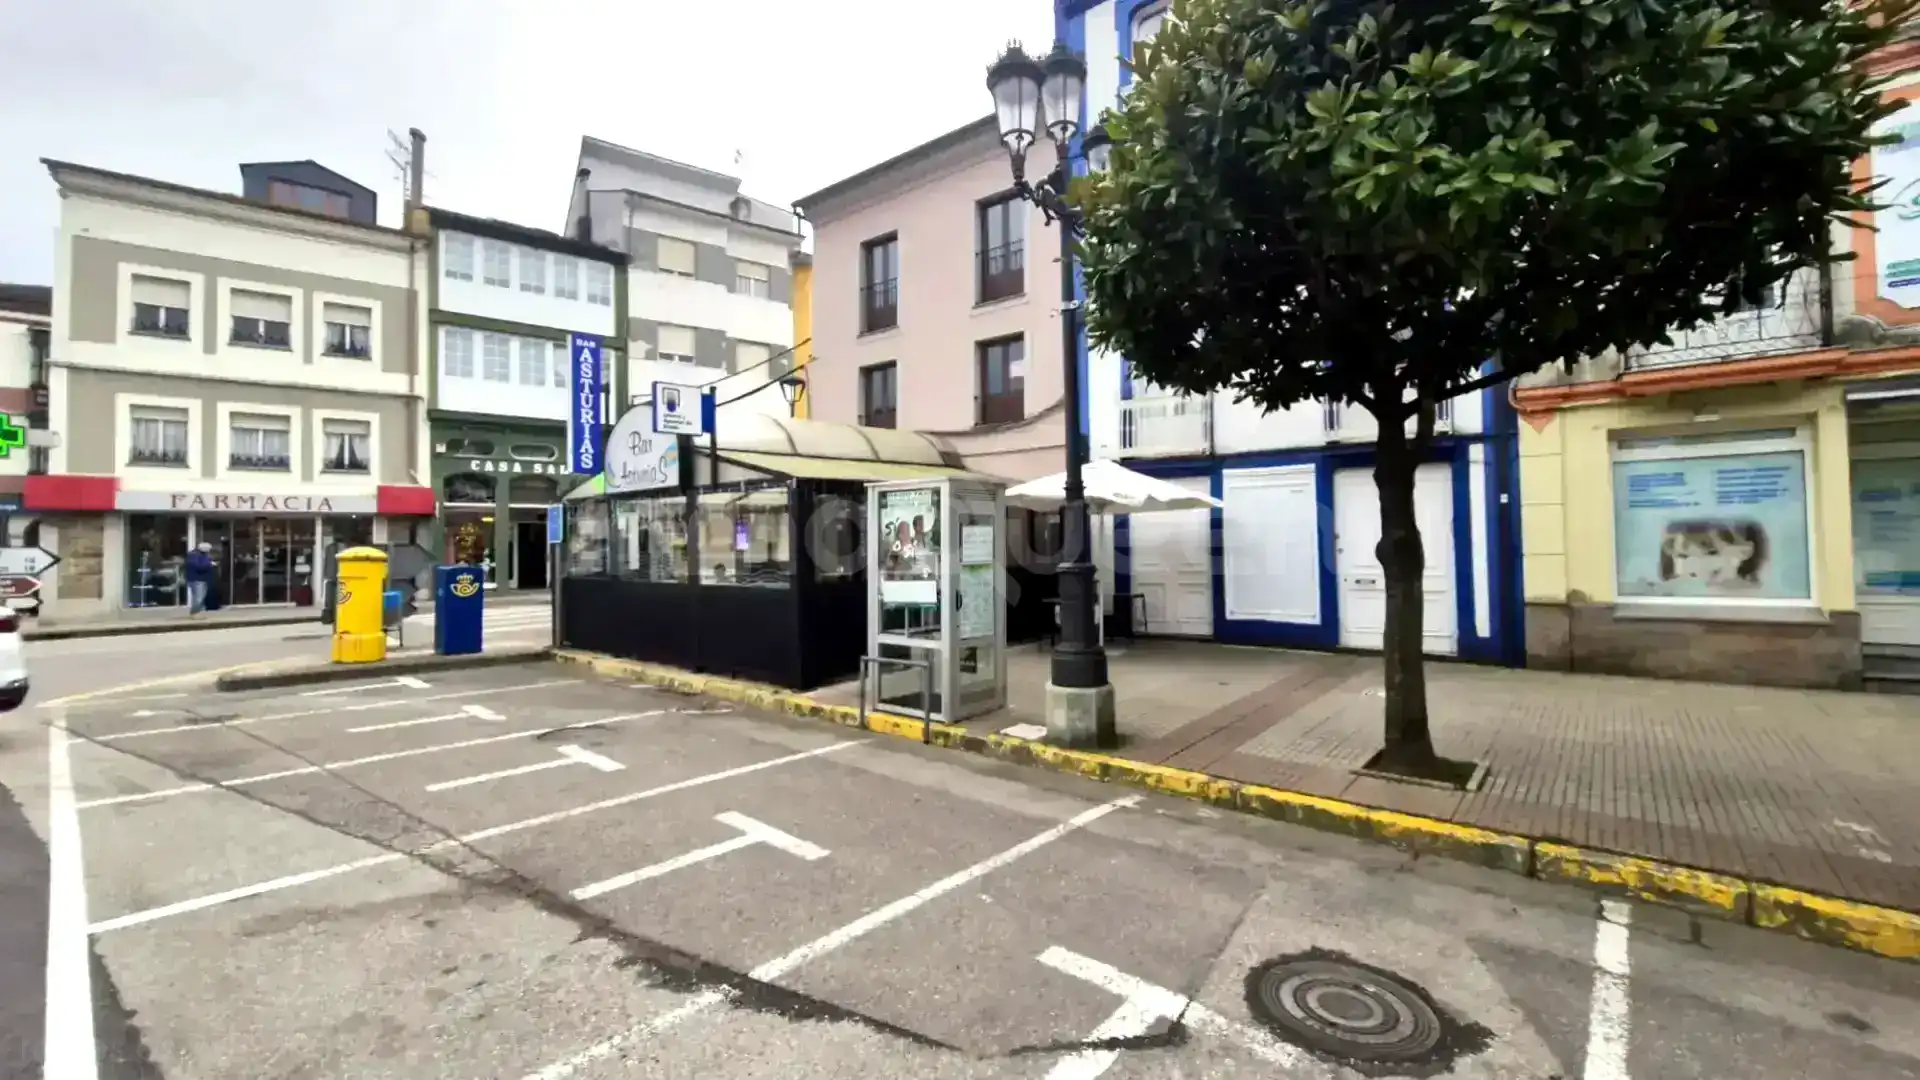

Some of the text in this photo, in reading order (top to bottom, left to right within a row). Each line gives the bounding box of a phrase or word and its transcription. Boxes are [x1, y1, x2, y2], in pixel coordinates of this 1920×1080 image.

[579, 347, 596, 469] ASTURIAS
[628, 430, 653, 456] Bar
[470, 460, 522, 473] CASA
[170, 493, 333, 512] FARMACIA
